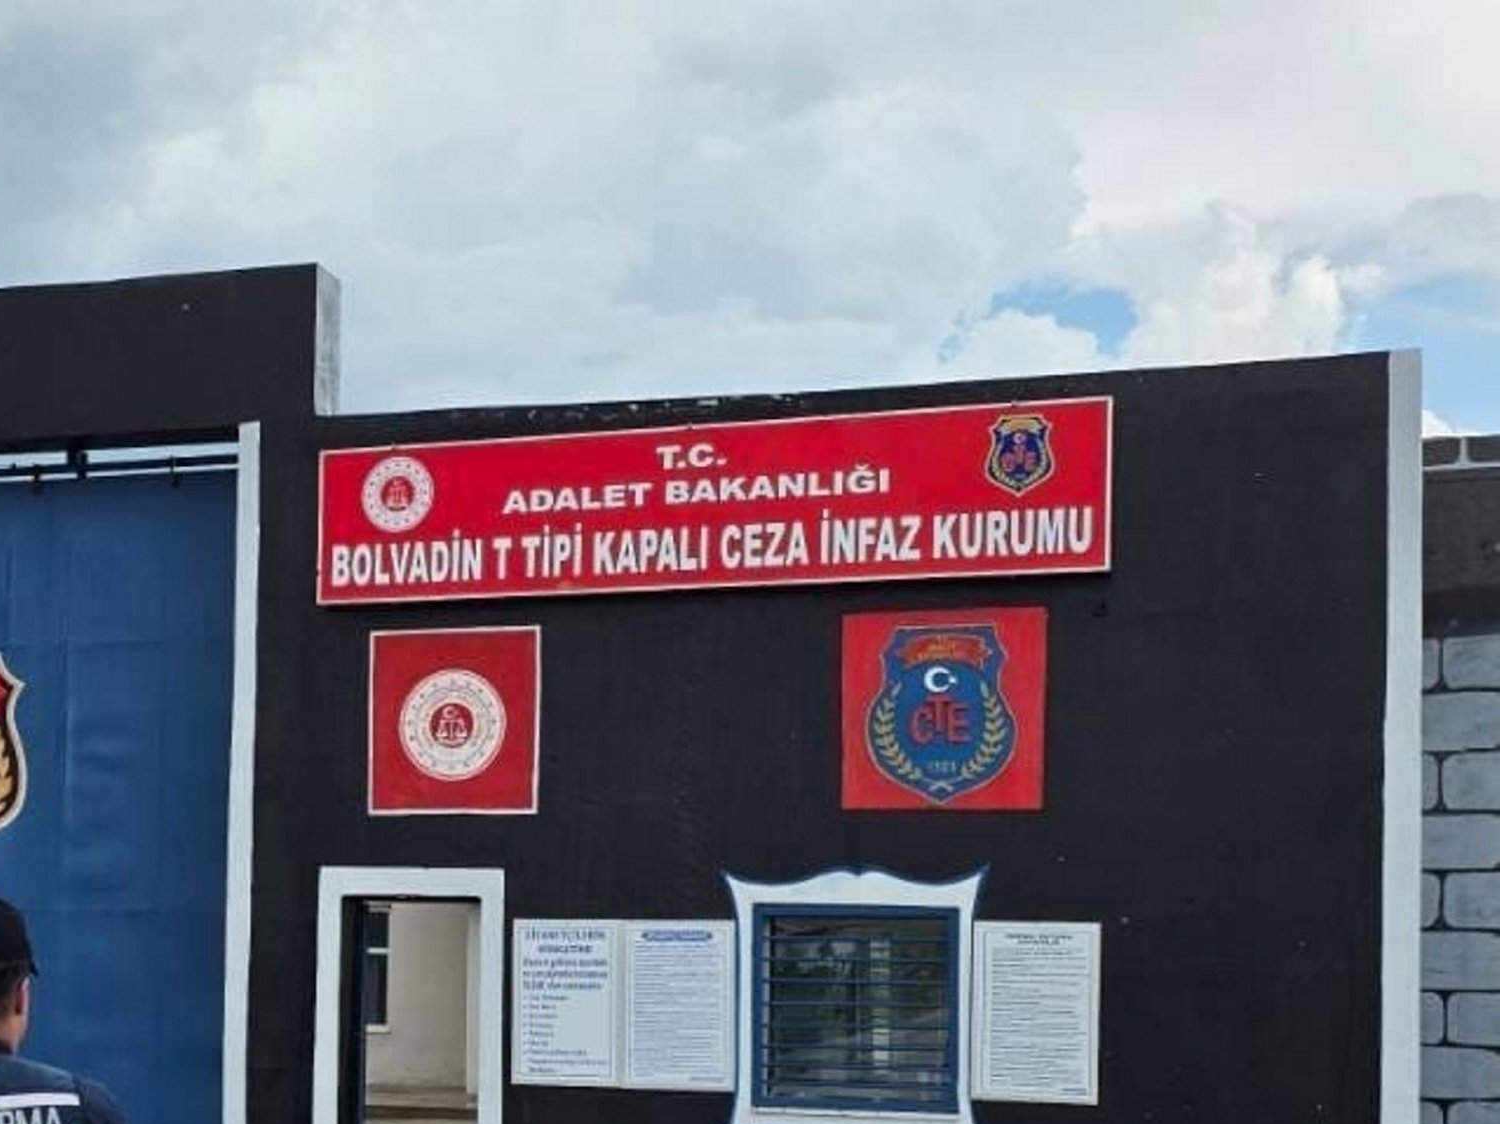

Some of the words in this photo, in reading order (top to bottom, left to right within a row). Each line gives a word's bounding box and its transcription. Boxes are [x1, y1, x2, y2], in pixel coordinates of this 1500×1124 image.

[656, 443, 727, 470] T.C.
[502, 482, 652, 514] ADALET
[665, 464, 890, 505] BAKANLIĞI
[331, 529, 483, 587] BOLVADİN
[493, 537, 512, 580] T
[521, 522, 582, 578] TİPİ
[593, 526, 709, 575] KAPALI
[721, 521, 809, 569] CEZA
[820, 508, 921, 565] İNFAZ
[932, 506, 1092, 560] KURUMU
